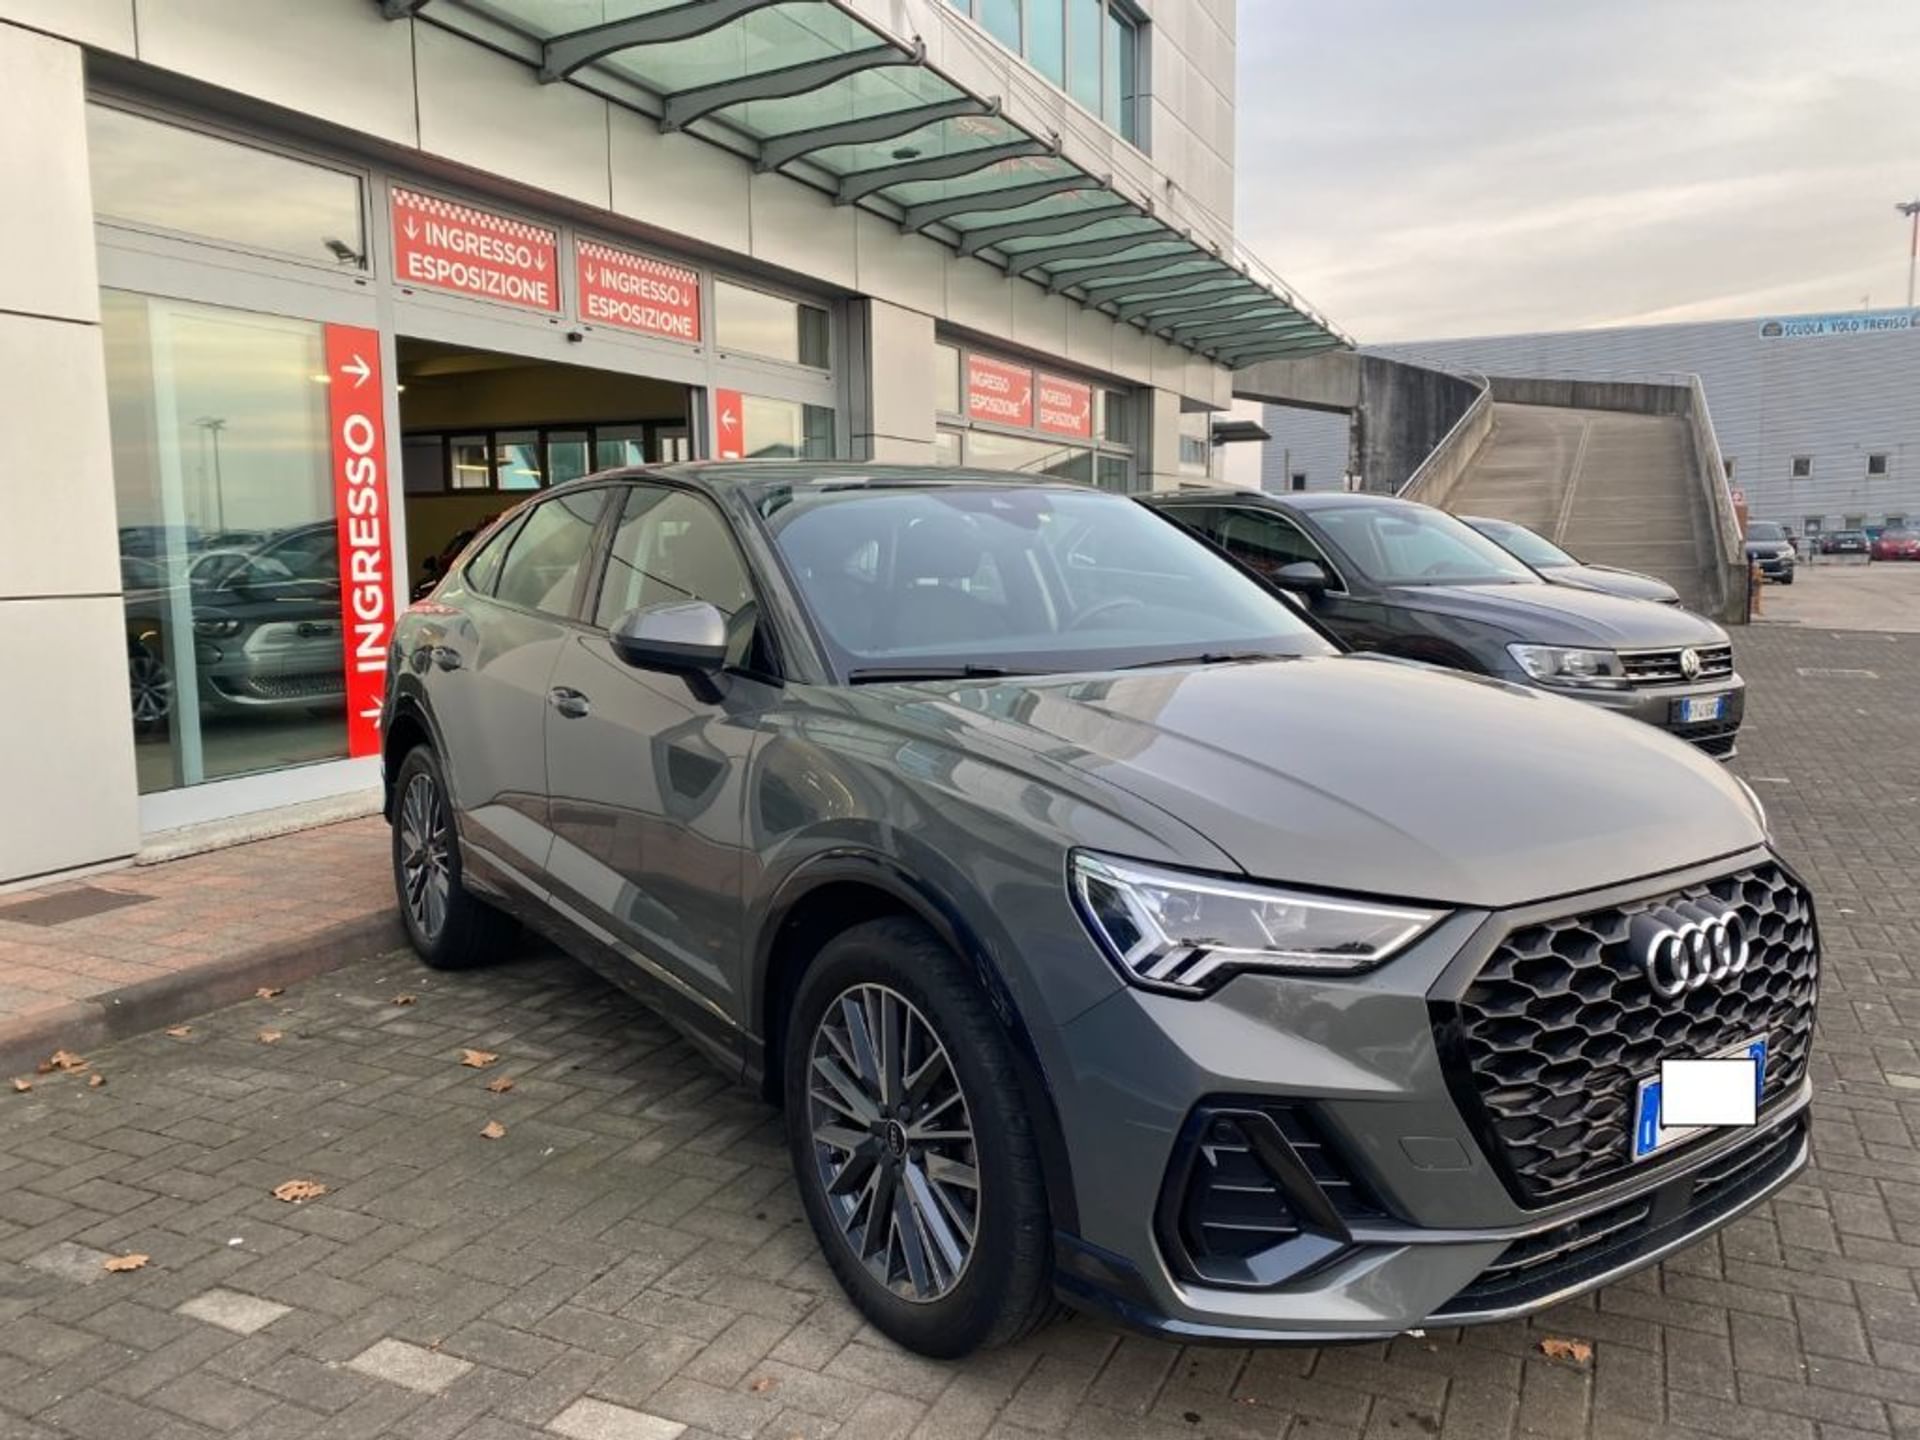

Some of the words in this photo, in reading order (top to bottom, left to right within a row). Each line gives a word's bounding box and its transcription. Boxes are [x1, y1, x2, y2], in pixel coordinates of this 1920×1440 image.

[425, 222, 532, 268] INGRESSO
[408, 253, 549, 305] ESPOSIZIONE
[601, 268, 680, 304] INGRESSO
[588, 294, 692, 336] ESPOSIZIONE
[1784, 322, 1824, 337] SCUOLA
[1831, 320, 1860, 333] VOLO
[1863, 316, 1908, 331] TREVISO
[970, 370, 1010, 393] INGRESSO
[969, 393, 1021, 418] ESPOSIZIONE
[1040, 388, 1072, 408] INGRESSO
[1039, 408, 1081, 430] ESPOSIZIONE
[343, 414, 388, 672] INGRESSO
